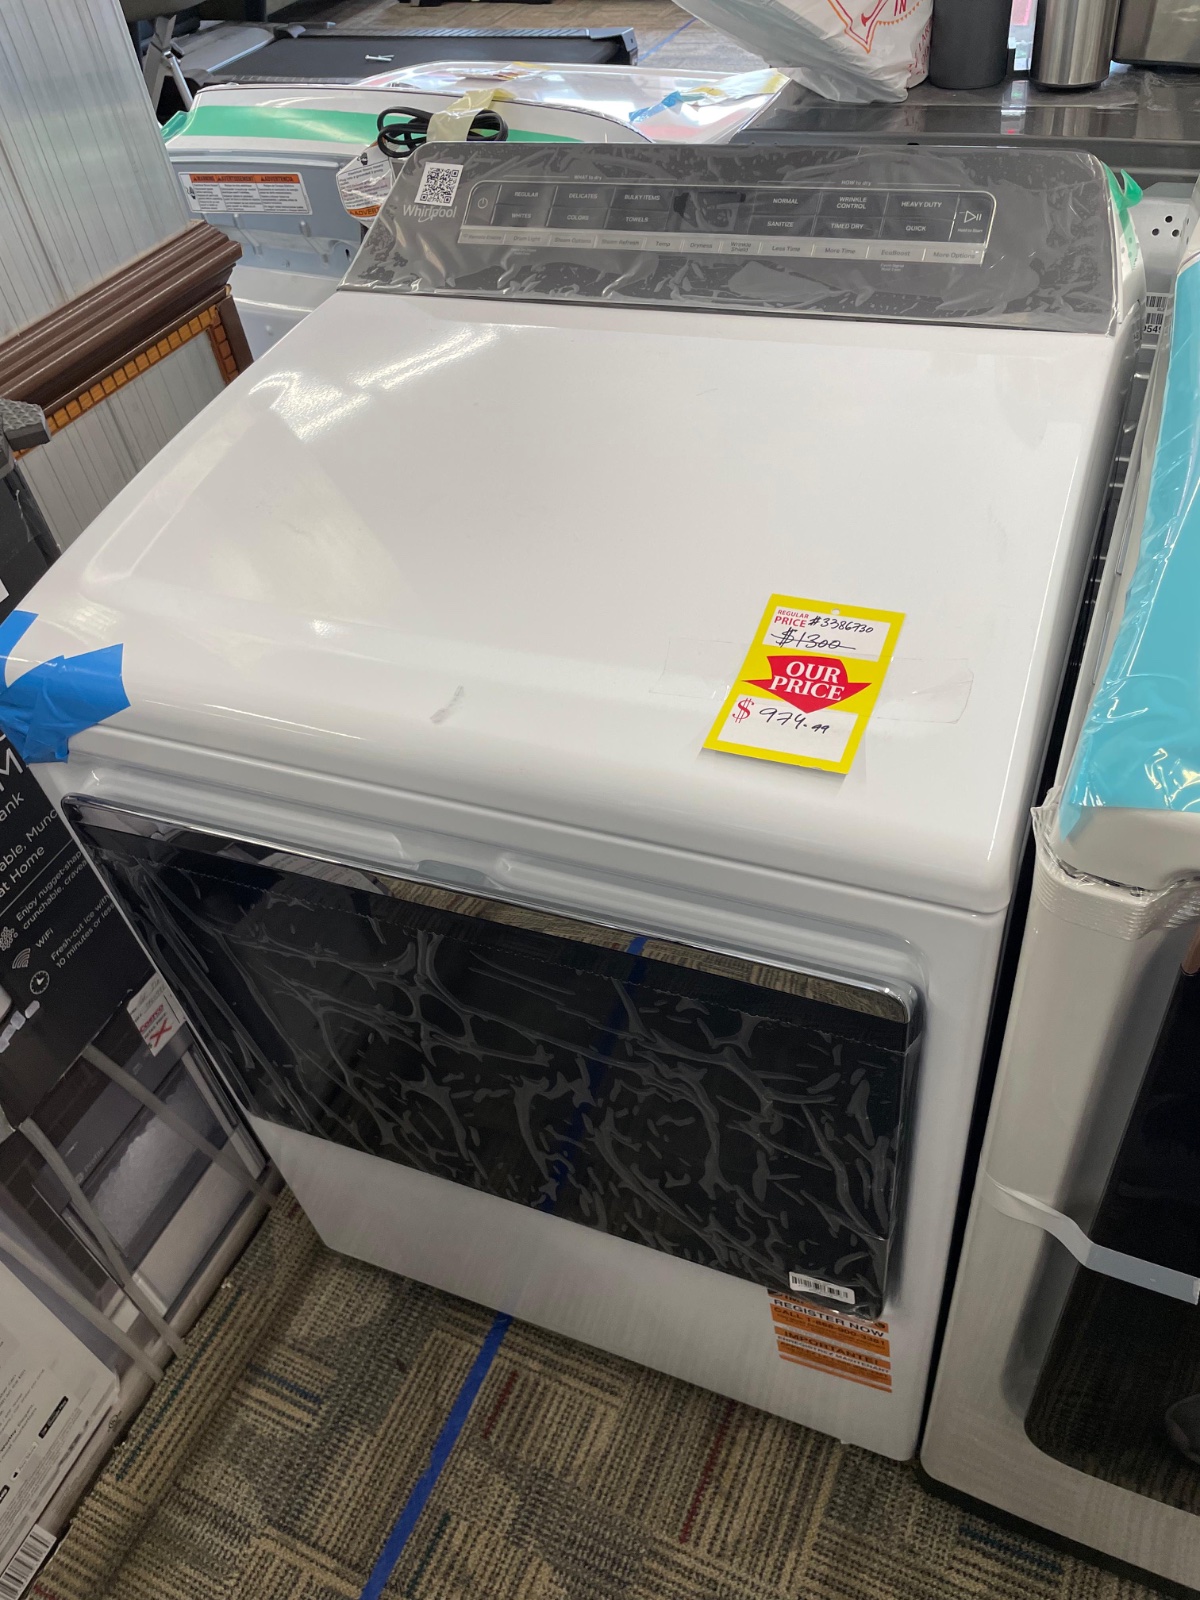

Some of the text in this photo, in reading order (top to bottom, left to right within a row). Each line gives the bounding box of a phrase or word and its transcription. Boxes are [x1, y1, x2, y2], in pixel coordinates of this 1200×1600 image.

[403, 204, 458, 223] Whirlpool
[773, 615, 807, 628] PRICE
[777, 609, 810, 620] REGULAR
[785, 661, 841, 684] OUR
[768, 675, 846, 701] PRICE
[732, 698, 754, 723] $
[10, 846, 45, 883] Home
[16, 851, 82, 922] Enjoy nugget-shap
[23, 886, 64, 930] crunchable,
[35, 927, 54, 948] WiFi
[51, 894, 110, 961] Fresh-cut ice with
[56, 903, 115, 969] 10 minutes or less
[774, 1307, 804, 1319] CALL
[774, 1299, 844, 1326] REGISTER
[849, 1323, 884, 1337] NOW
